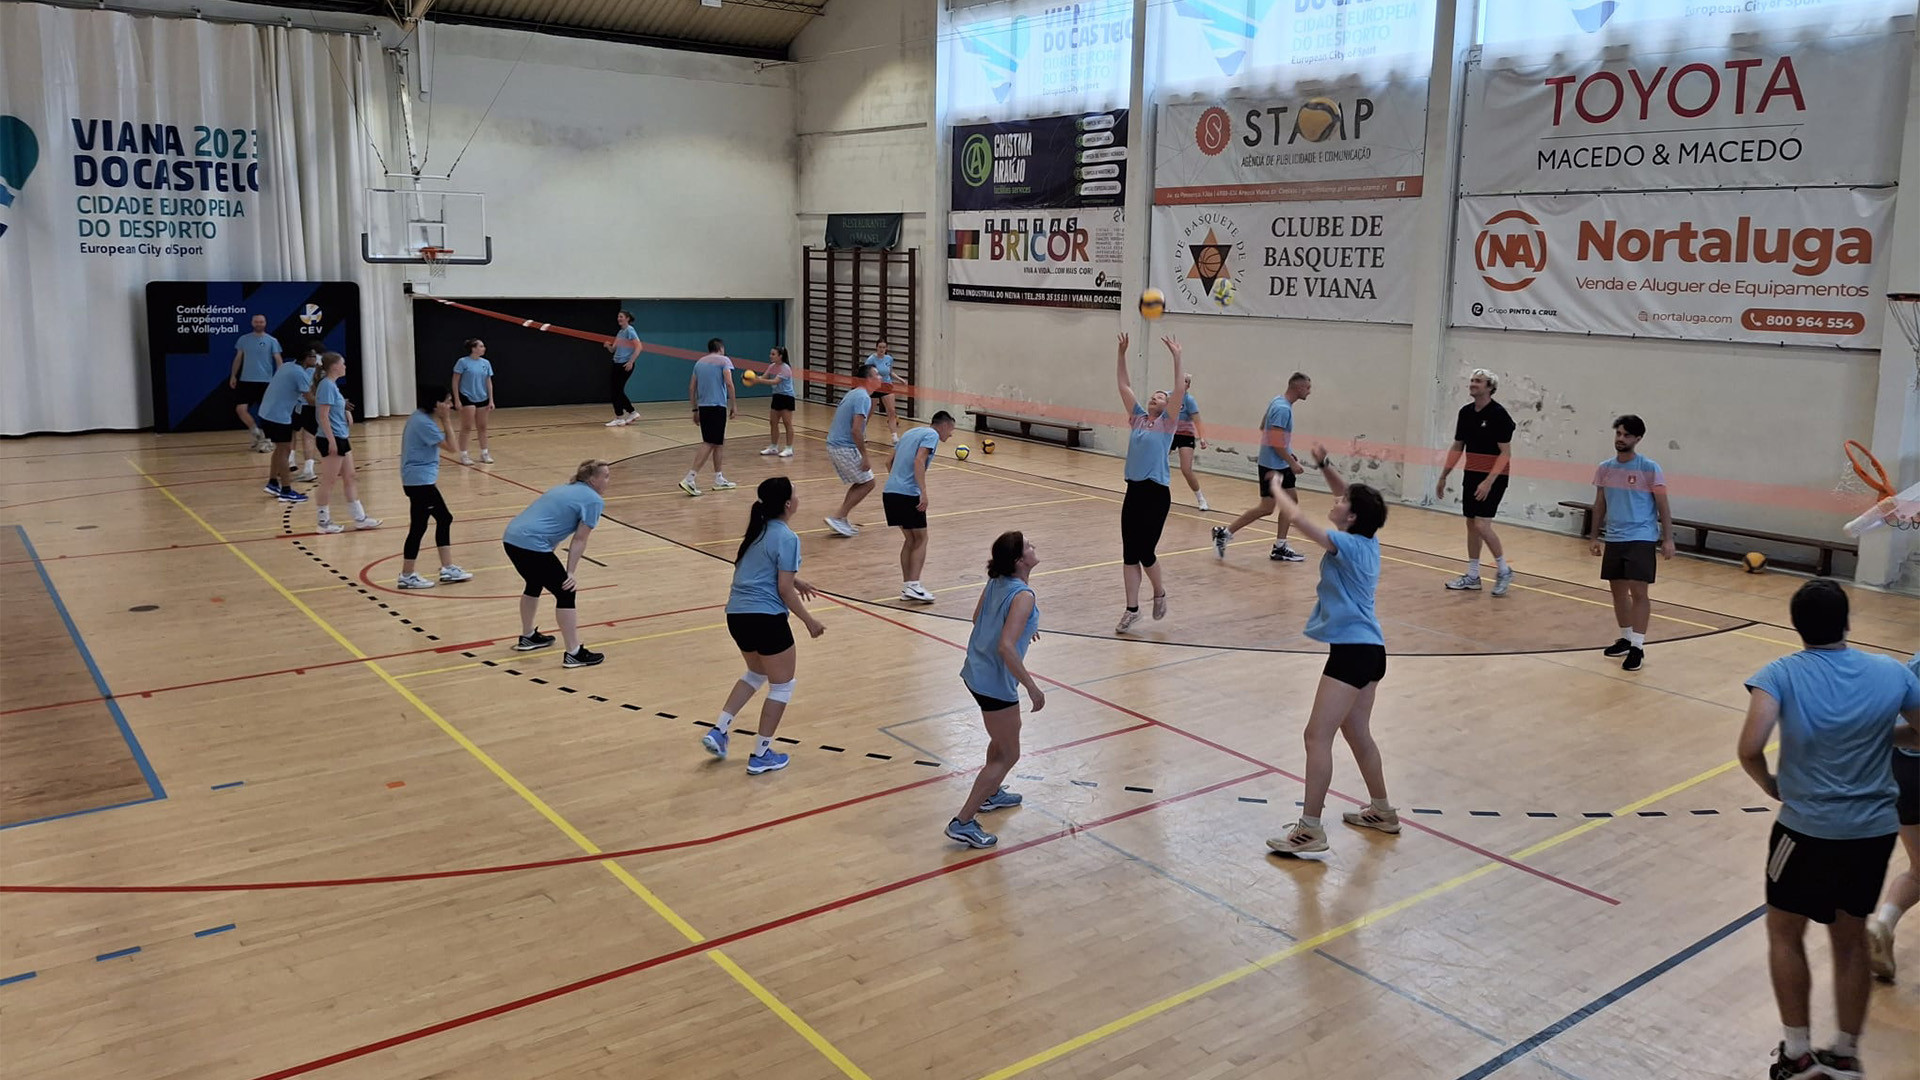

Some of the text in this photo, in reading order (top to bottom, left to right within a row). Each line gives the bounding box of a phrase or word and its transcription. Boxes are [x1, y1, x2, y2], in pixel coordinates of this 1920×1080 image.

[1329, 49, 1345, 61] City
[1544, 56, 1807, 127] TOYOTA
[71, 118, 185, 156] VIANA
[994, 132, 1033, 158] CRISTINA
[1266, 154, 1275, 166] DE
[1537, 138, 1803, 171] MACEDO & MACEDO
[994, 158, 1027, 184] ARAÚJO
[77, 196, 246, 218] CIDADE EUROPEIA
[78, 219, 217, 240] DO DESPORTO
[986, 217, 1077, 234] TINTAS
[1184, 213, 1240, 238] BASQUETE
[1271, 215, 1384, 238] CLUBE DE
[80, 243, 137, 256] European
[138, 243, 162, 258] City
[173, 244, 203, 257] Sport
[989, 228, 1090, 262] BRICOR
[1174, 239, 1186, 259] DE
[1236, 241, 1247, 261] DE
[1576, 216, 1873, 277] Nortaluga
[1263, 246, 1385, 273] BASQUETE
[966, 289, 996, 298] INDUSTRIAL
[996, 291, 1004, 299] DO
[1072, 295, 1093, 303] VIANA
[1174, 265, 1198, 306] CLUBE
[1269, 276, 1378, 300] DE VIANA
[1575, 276, 1869, 298] Venda e Aluguer de Equipamentos
[176, 305, 247, 314] Confédération
[176, 315, 234, 325] Européenne
[1509, 308, 1531, 316] PINTO
[1538, 309, 1558, 317] CRUZ
[1652, 312, 1733, 325] nortaluga.com
[177, 325, 239, 335] de Volleyball
[300, 326, 323, 334] CEV
[1766, 315, 1855, 329] 800 964 554
